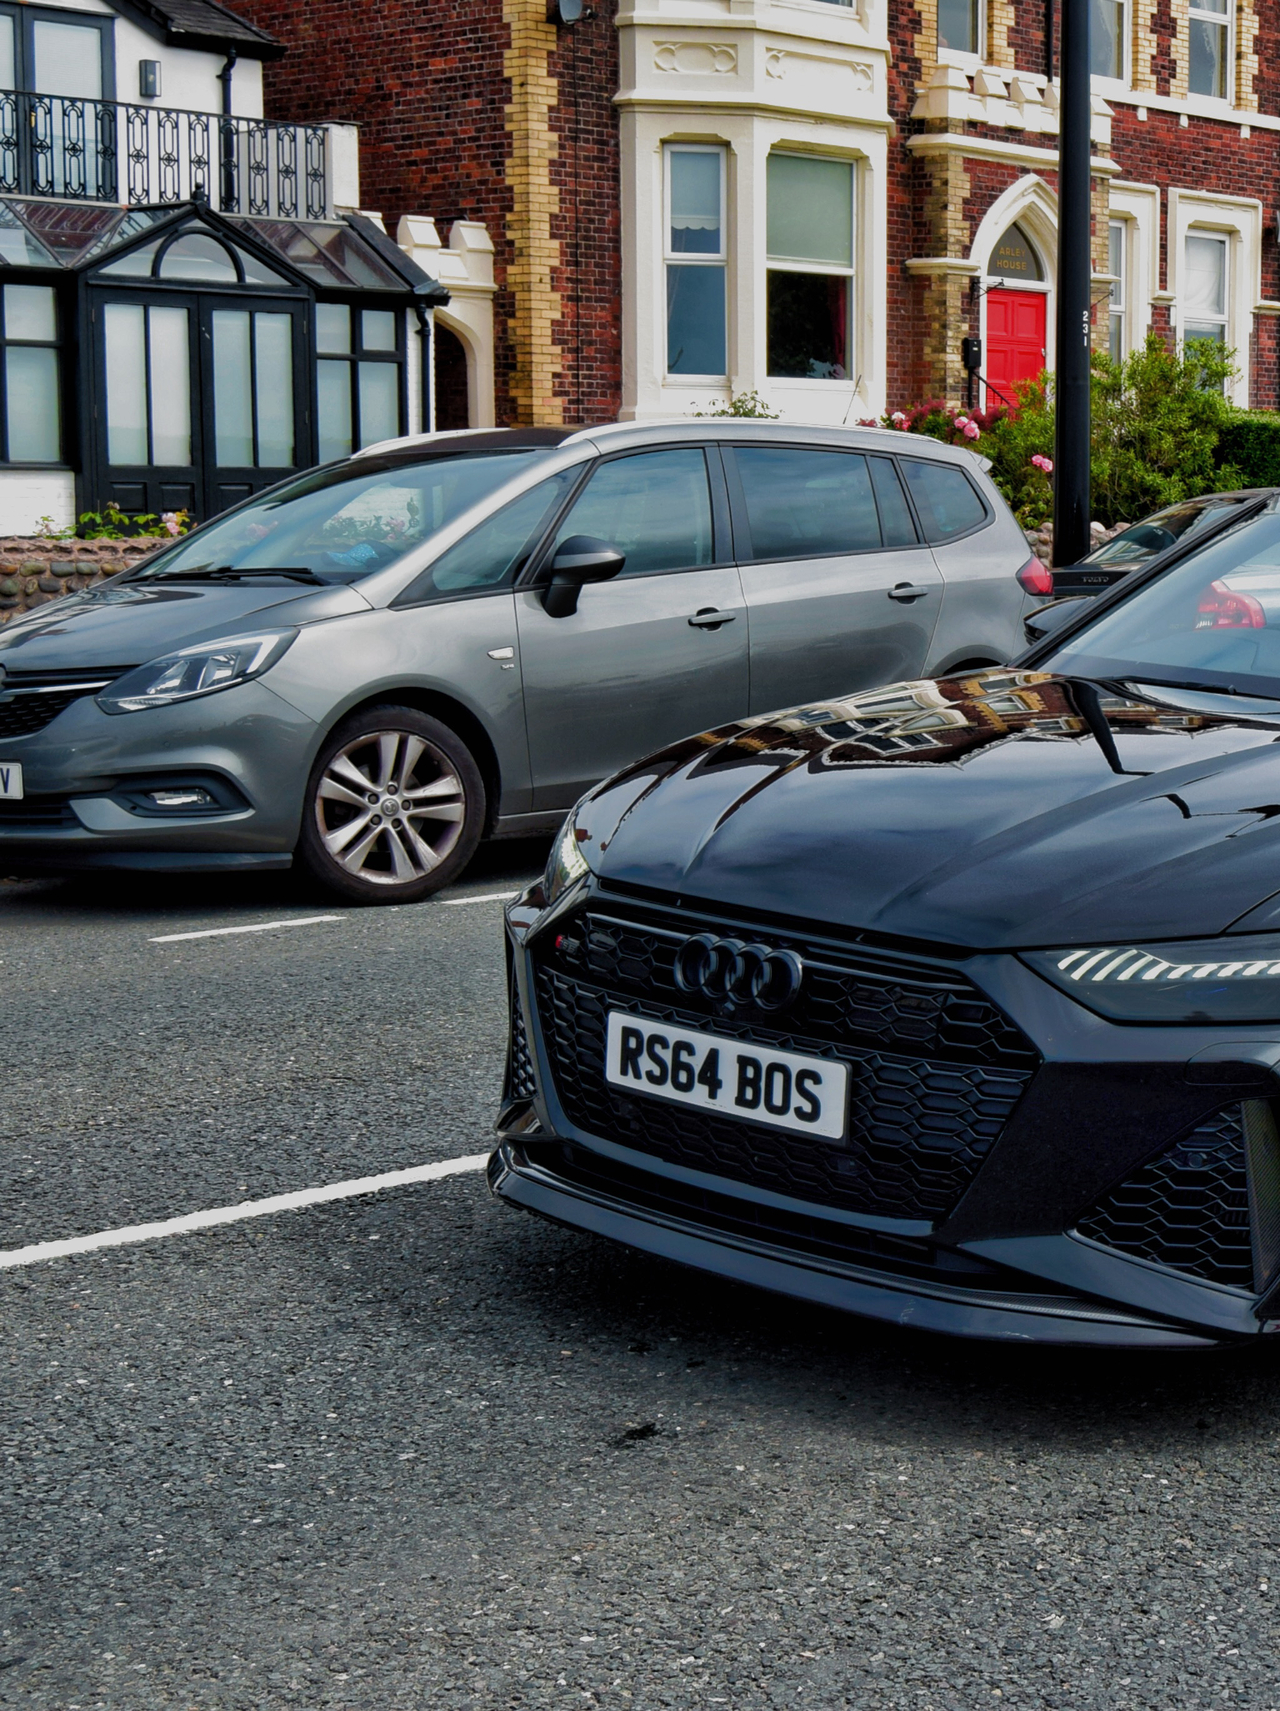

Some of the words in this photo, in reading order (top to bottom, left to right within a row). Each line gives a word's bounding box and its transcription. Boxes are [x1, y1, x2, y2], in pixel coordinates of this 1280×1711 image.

[999, 247, 1025, 257] ARLEY
[997, 260, 1027, 270] HOUSE
[619, 1025, 723, 1100] RS64
[735, 1054, 823, 1123] BOS
